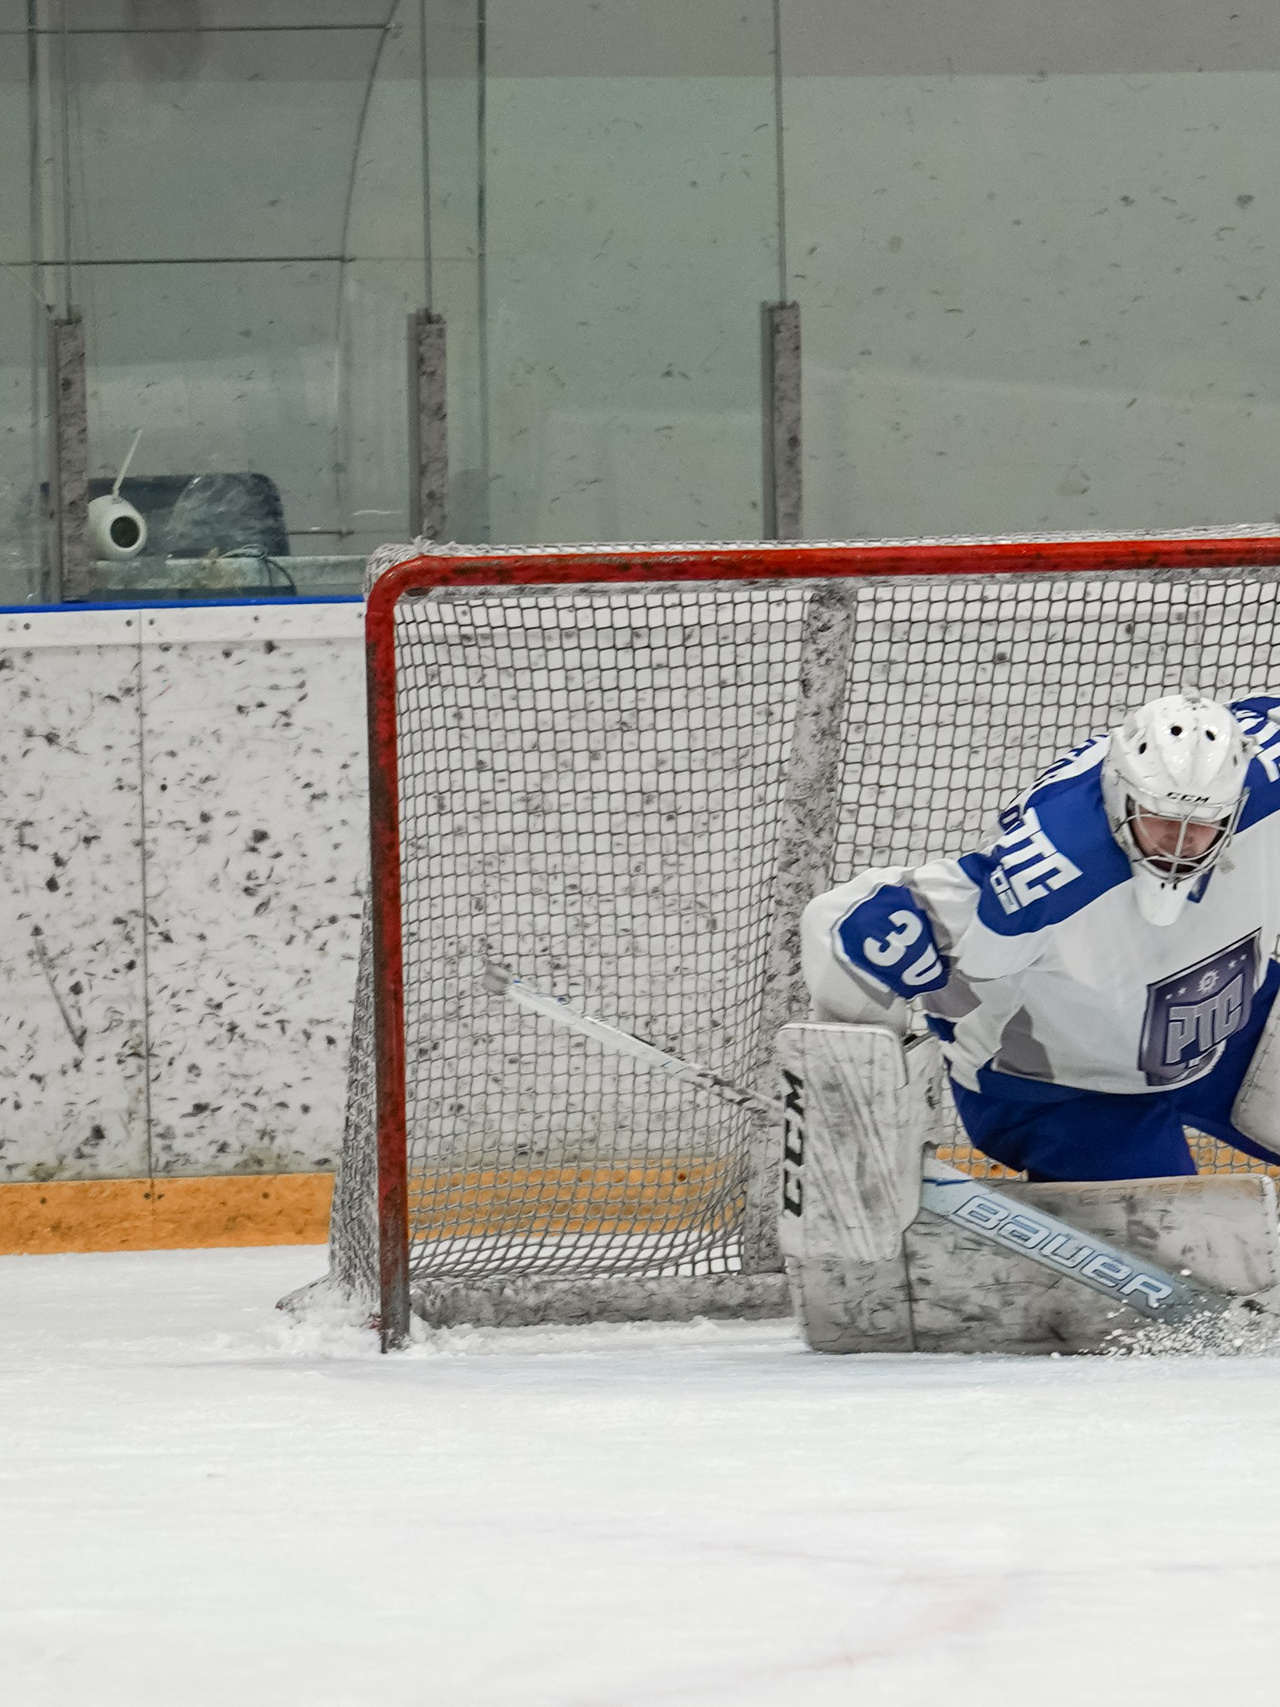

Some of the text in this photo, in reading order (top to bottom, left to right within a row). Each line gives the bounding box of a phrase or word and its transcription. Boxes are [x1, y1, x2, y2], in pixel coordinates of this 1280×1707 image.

[1165, 791, 1211, 804] CCM
[782, 1069, 804, 1217] CCM
[953, 1194, 1174, 1309] BAUER
